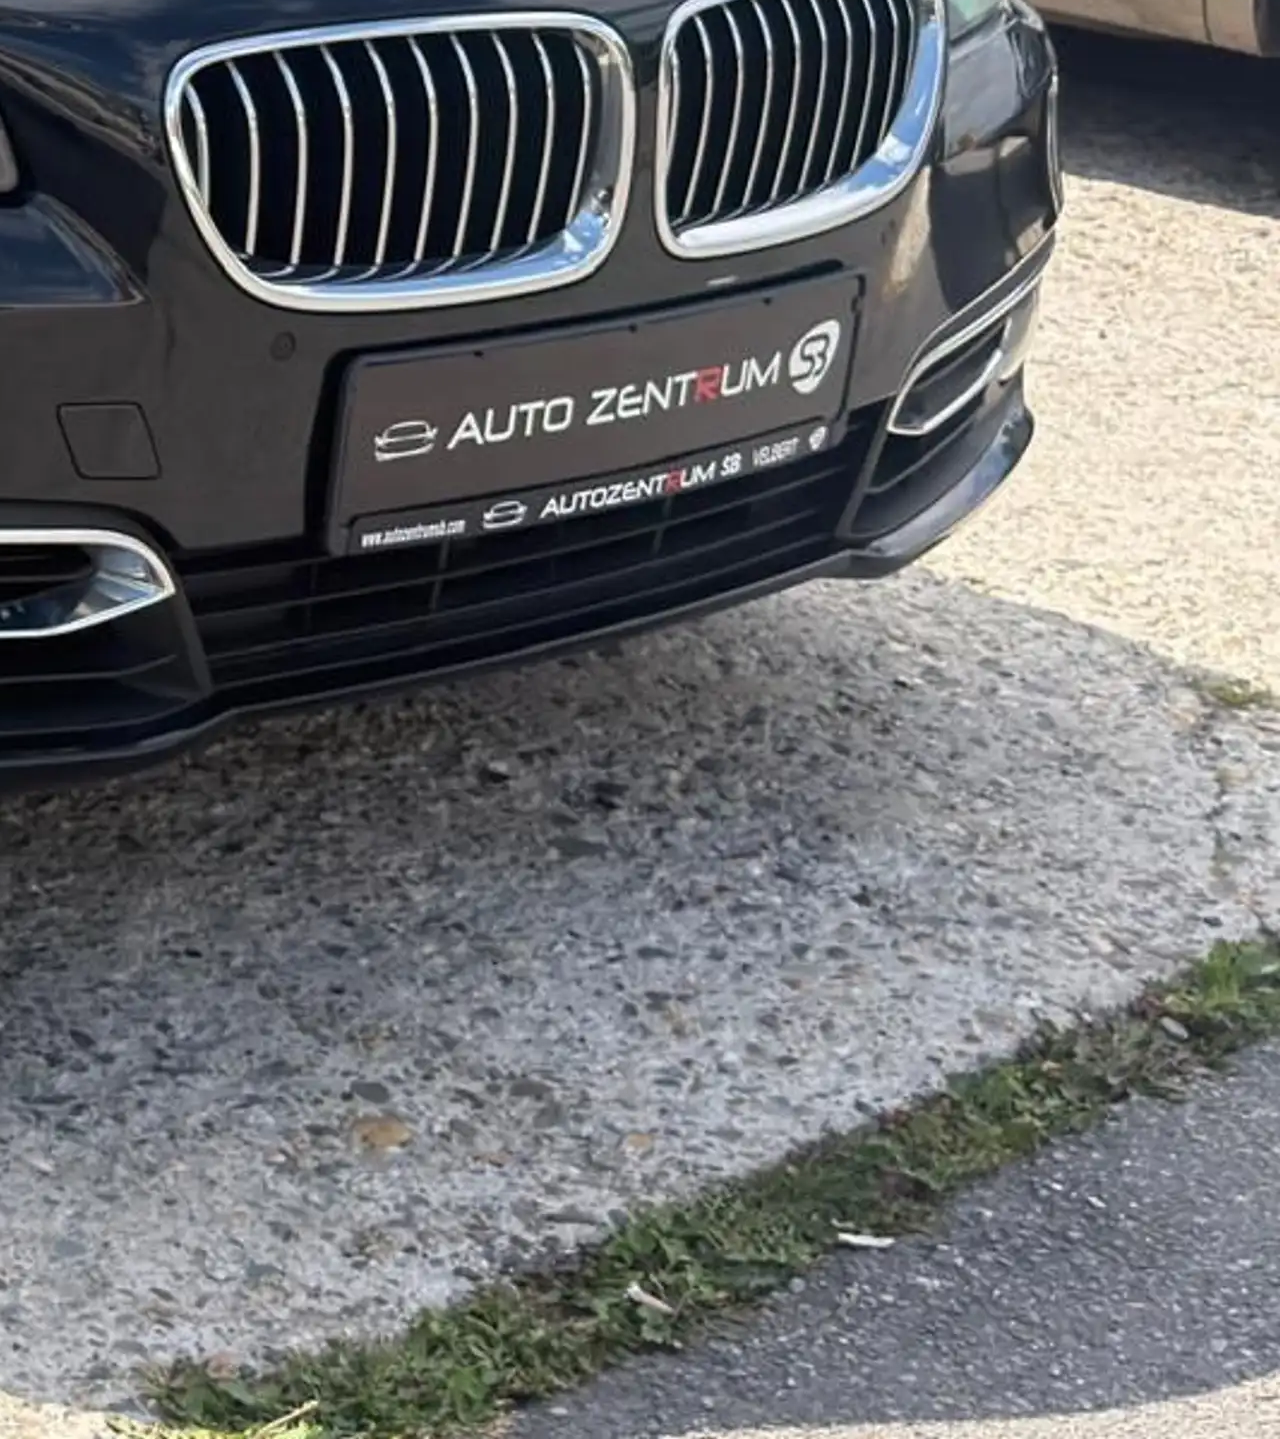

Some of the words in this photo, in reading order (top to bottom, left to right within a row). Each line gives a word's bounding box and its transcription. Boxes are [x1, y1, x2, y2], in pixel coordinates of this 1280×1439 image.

[447, 397, 574, 450] AUTO
[586, 352, 781, 426] ZENTRUM
[540, 461, 716, 519] AUTOZENTRUM
